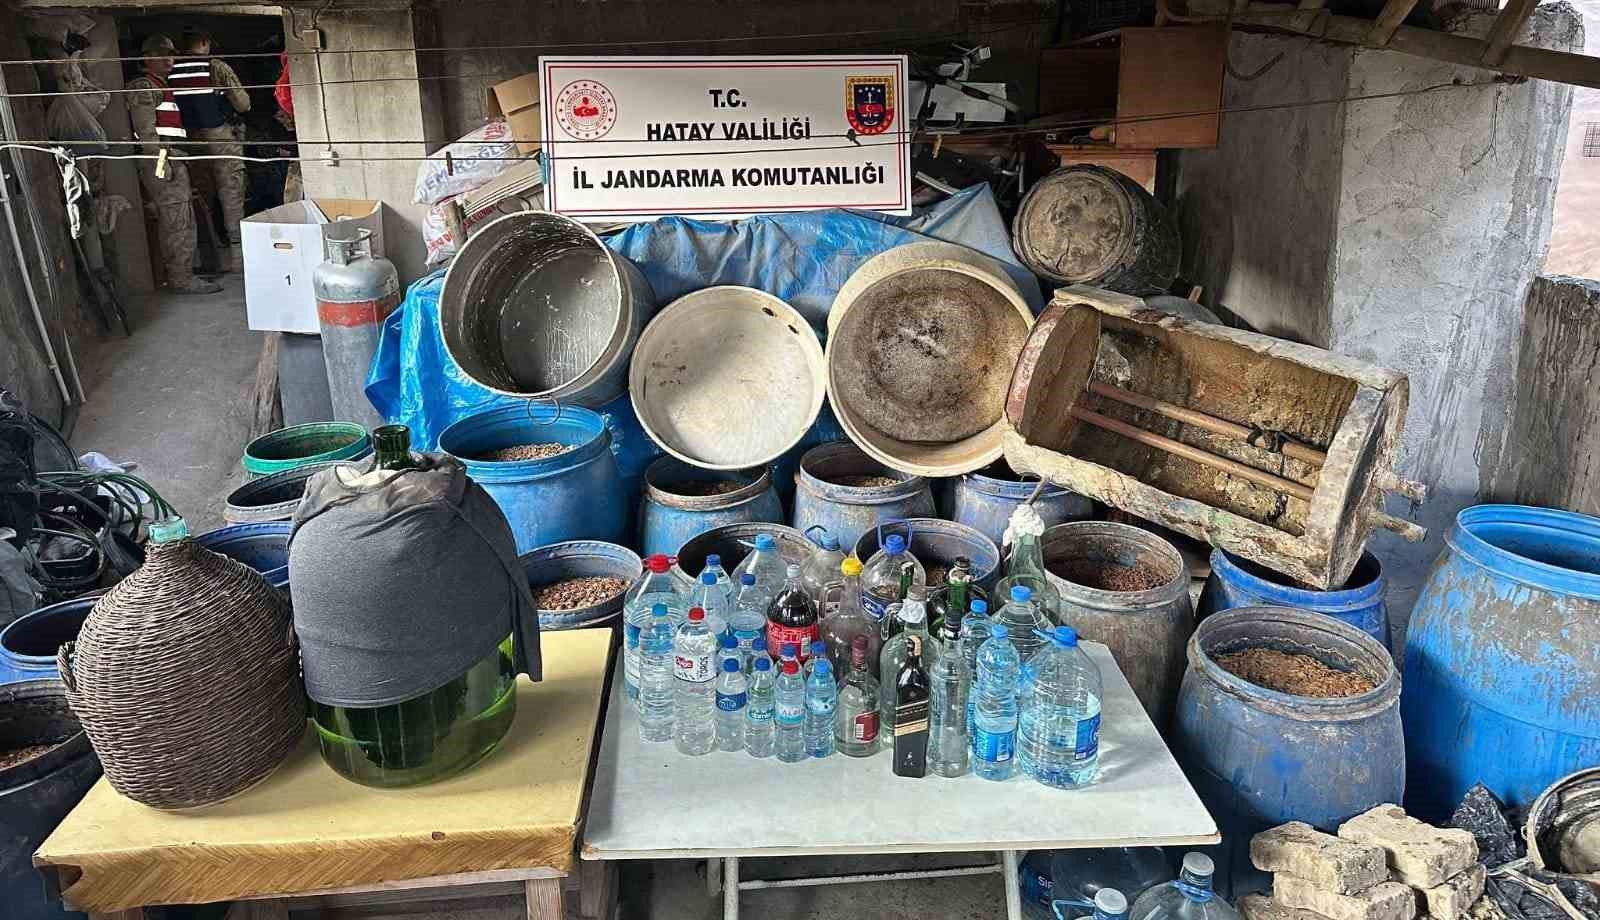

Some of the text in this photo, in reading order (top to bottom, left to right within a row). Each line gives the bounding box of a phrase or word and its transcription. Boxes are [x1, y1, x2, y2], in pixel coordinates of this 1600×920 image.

[709, 88, 747, 108] T.C.
[647, 117, 810, 141] HATAY VALİLİĞİ
[573, 161, 884, 189] İL JANDARMA KOMUTANLIĞI
[285, 274, 291, 286] 1
